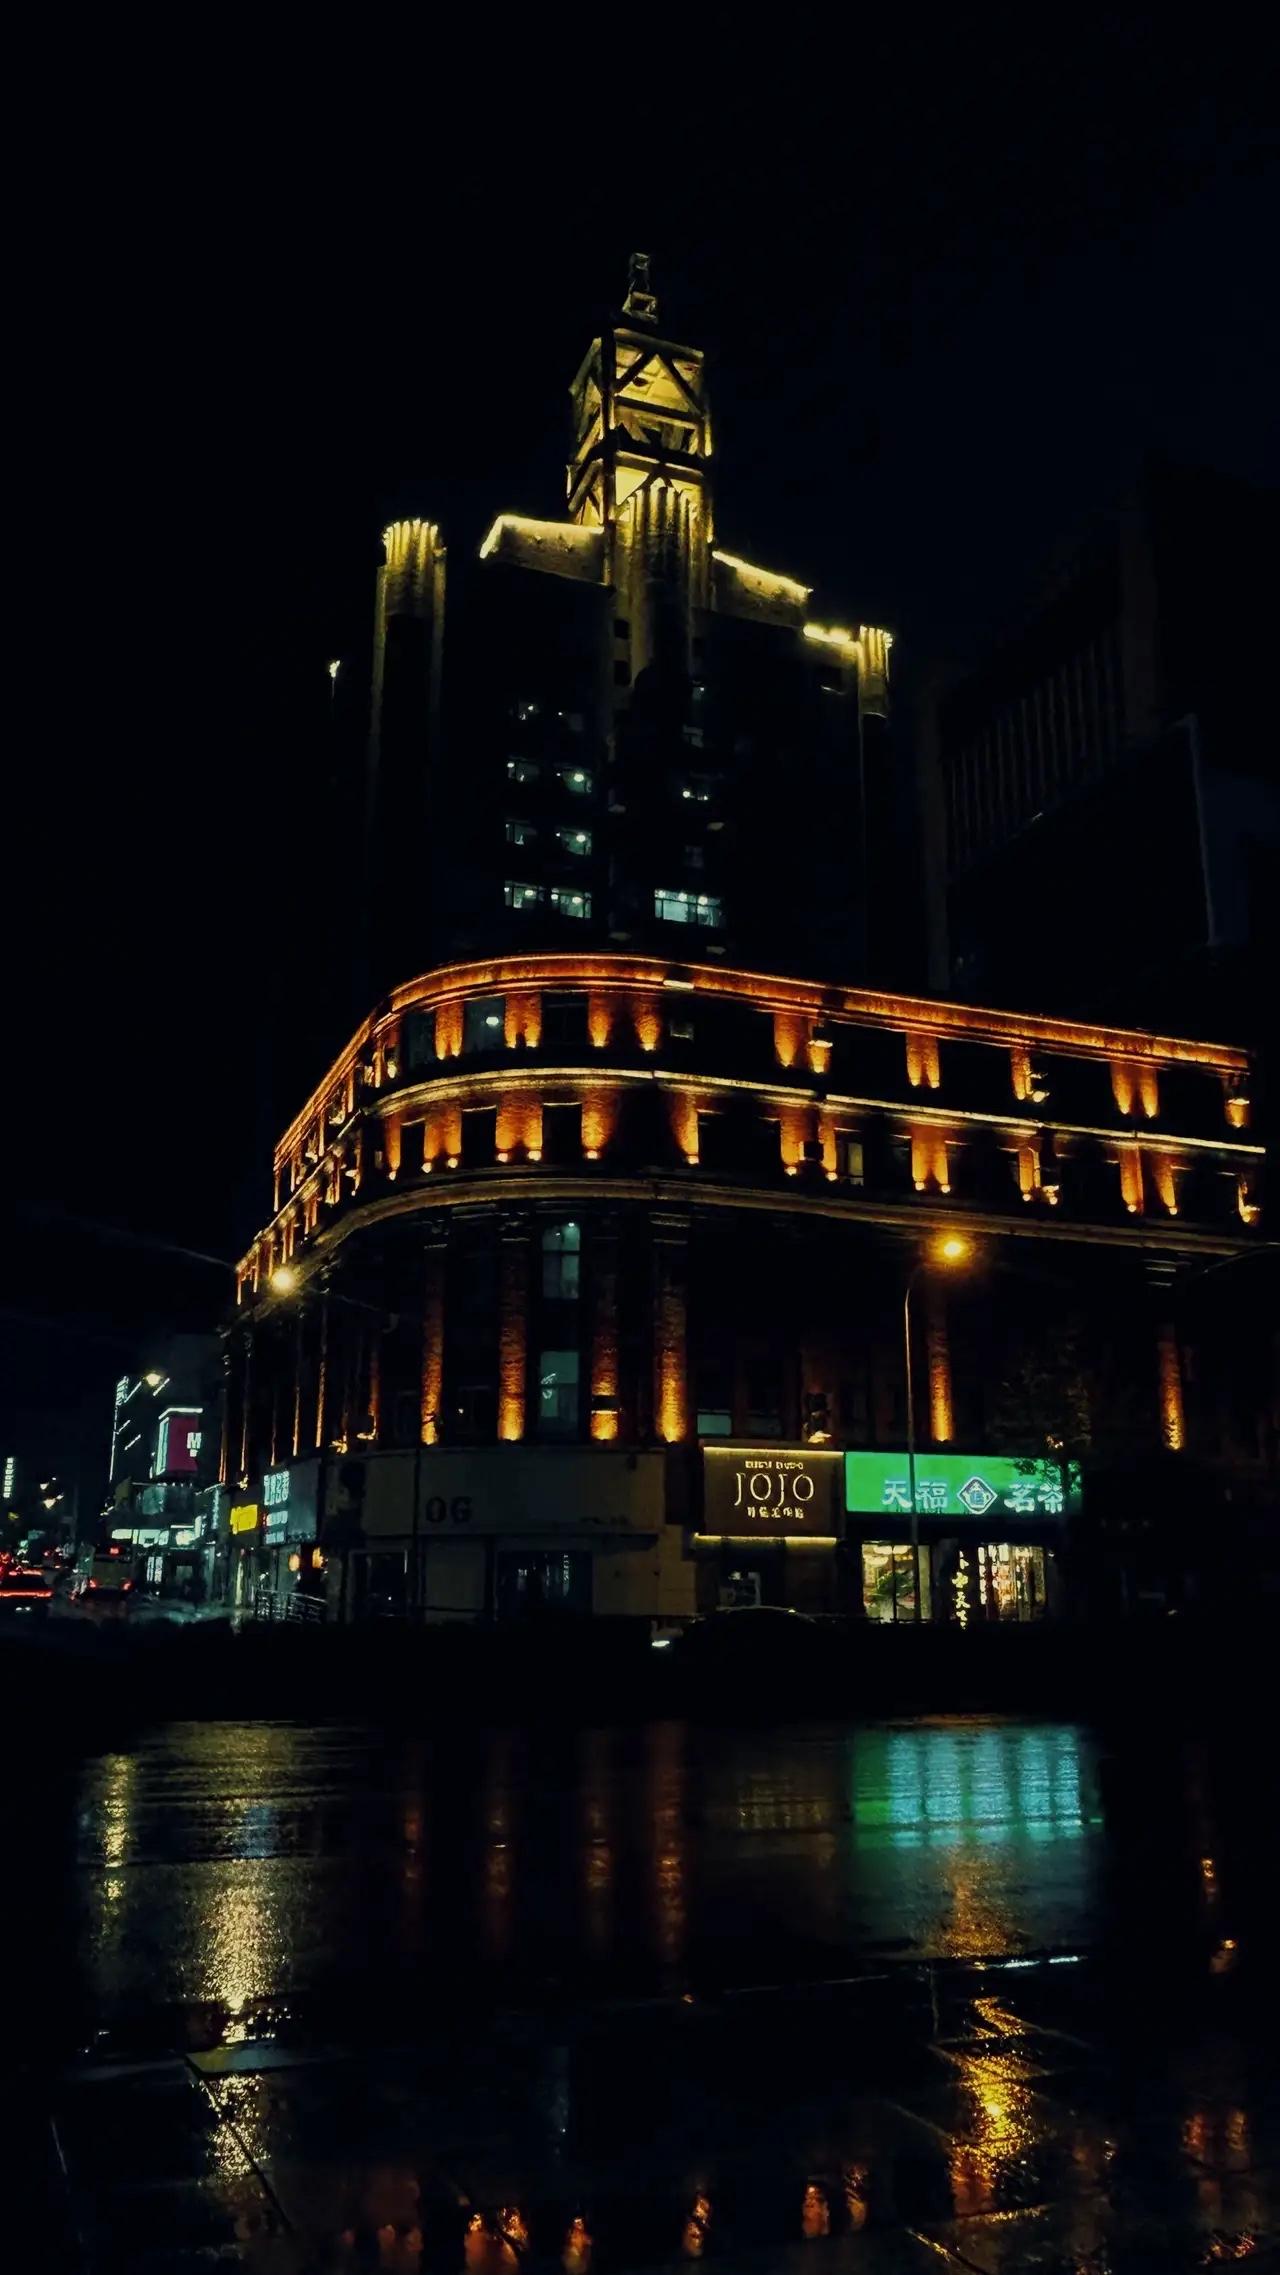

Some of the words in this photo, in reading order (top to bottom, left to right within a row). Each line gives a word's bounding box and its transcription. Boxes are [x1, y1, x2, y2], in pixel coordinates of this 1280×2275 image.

[734, 1473, 814, 1506] JOJO
[882, 1480, 948, 1509] 天福
[1004, 1483, 1064, 1513] 茗茶
